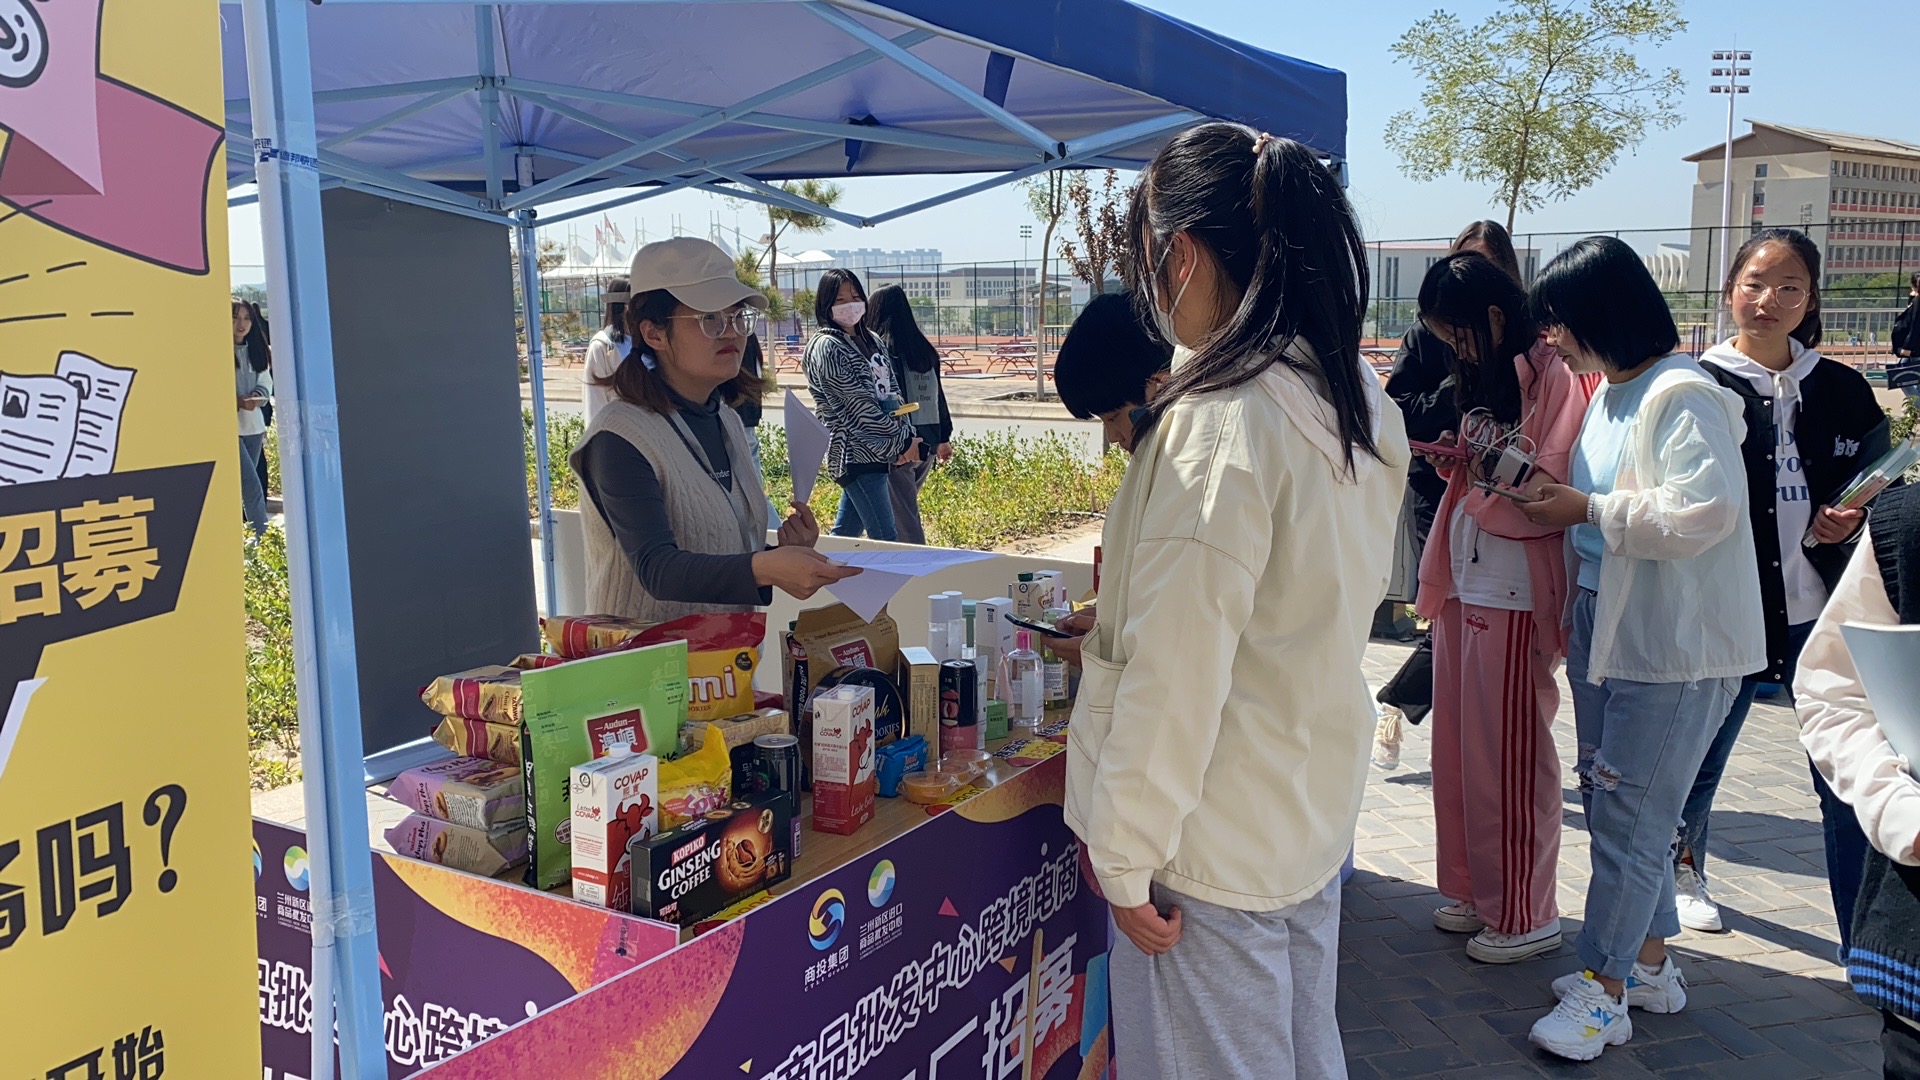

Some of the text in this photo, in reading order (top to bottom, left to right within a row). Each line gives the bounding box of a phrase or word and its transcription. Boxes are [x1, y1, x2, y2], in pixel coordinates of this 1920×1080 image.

[798, 686, 806, 702] FOOD
[852, 698, 871, 718] COVAP
[603, 719, 629, 731] Audun
[614, 768, 649, 790] COVAP
[658, 839, 722, 891] GINSENG
[673, 834, 705, 864] KOPIKO
[0, 784, 187, 950] 吗?
[671, 865, 711, 900] COFFEE
[860, 902, 903, 937] 兰州新区进口
[860, 915, 903, 950] 商品批发中心
[759, 842, 1080, 1080] 品批发中心跨境电商
[804, 944, 849, 986] 商投集团
